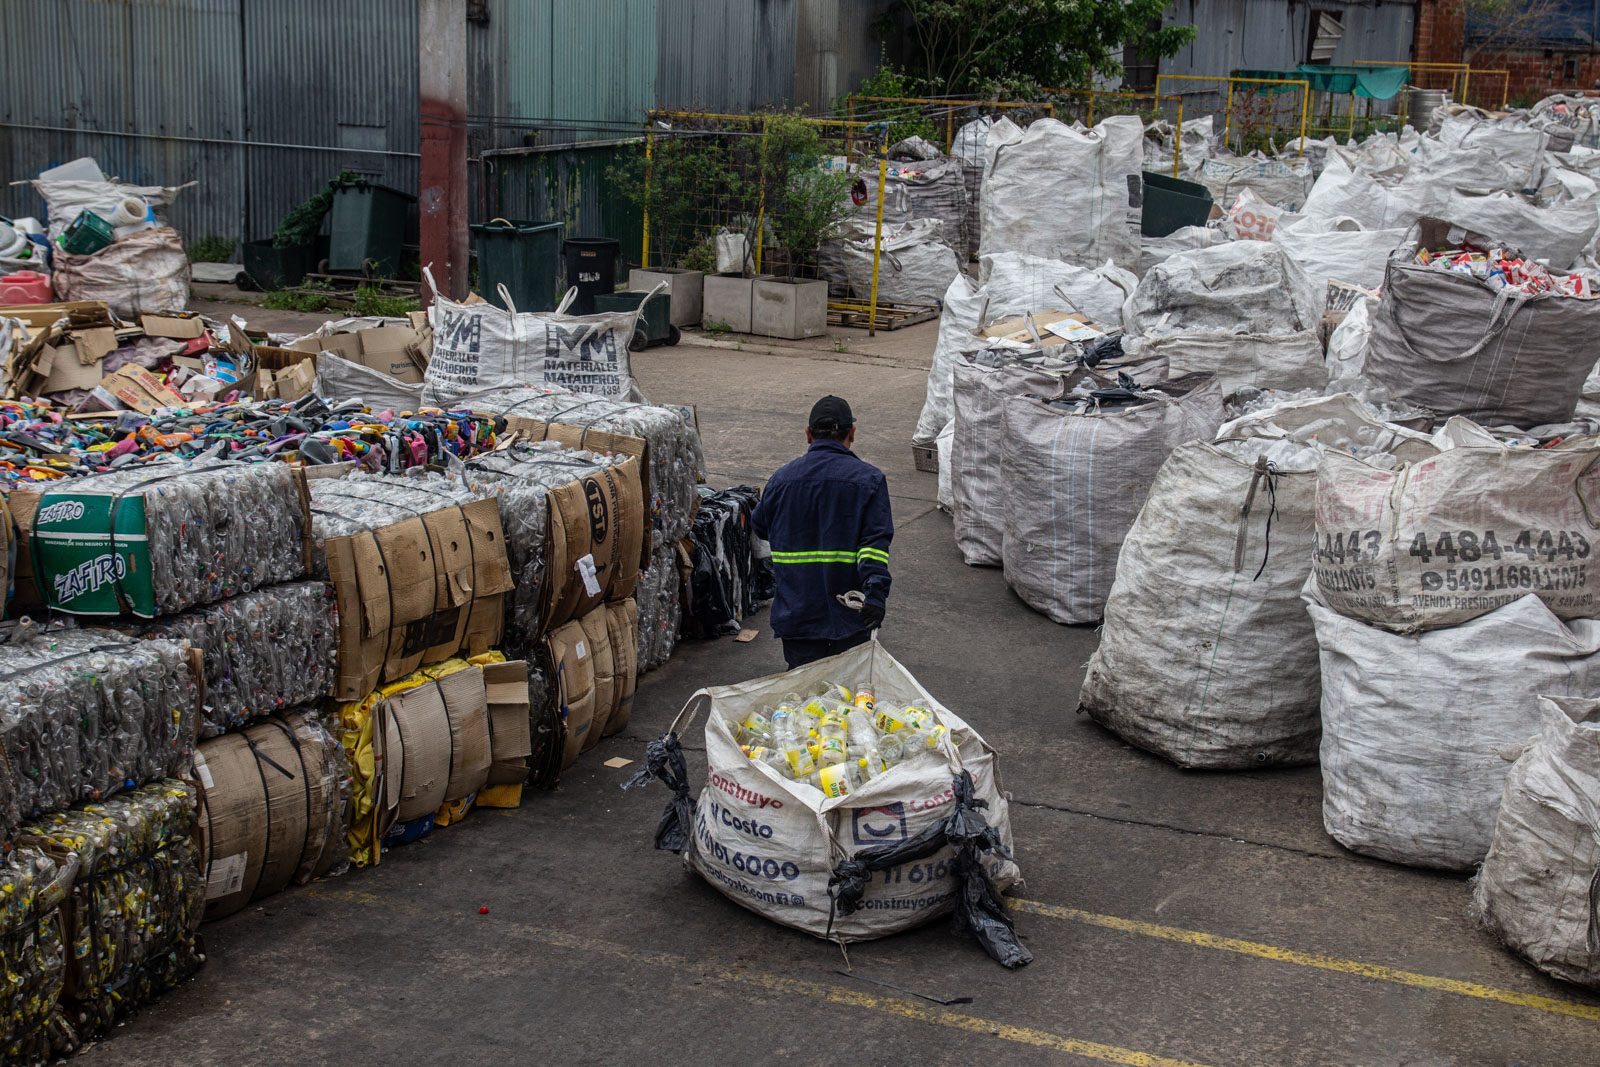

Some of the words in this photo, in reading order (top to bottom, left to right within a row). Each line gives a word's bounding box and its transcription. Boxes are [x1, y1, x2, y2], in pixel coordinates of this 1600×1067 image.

[431, 356, 478, 376] MATADEROS
[544, 360, 618, 372] MATERIALES
[544, 372, 620, 385] MATADEROS
[37, 500, 85, 525] ZAFIRO
[589, 487, 606, 532] TST
[1409, 530, 1591, 564] 4484-4443
[54, 552, 127, 605] ZAFIRO
[1446, 566, 1587, 592] 5491168117075
[1412, 594, 1450, 608] AVENIDA
[722, 807, 773, 839] Costo
[732, 851, 800, 881] 6000
[907, 860, 951, 884] 616
